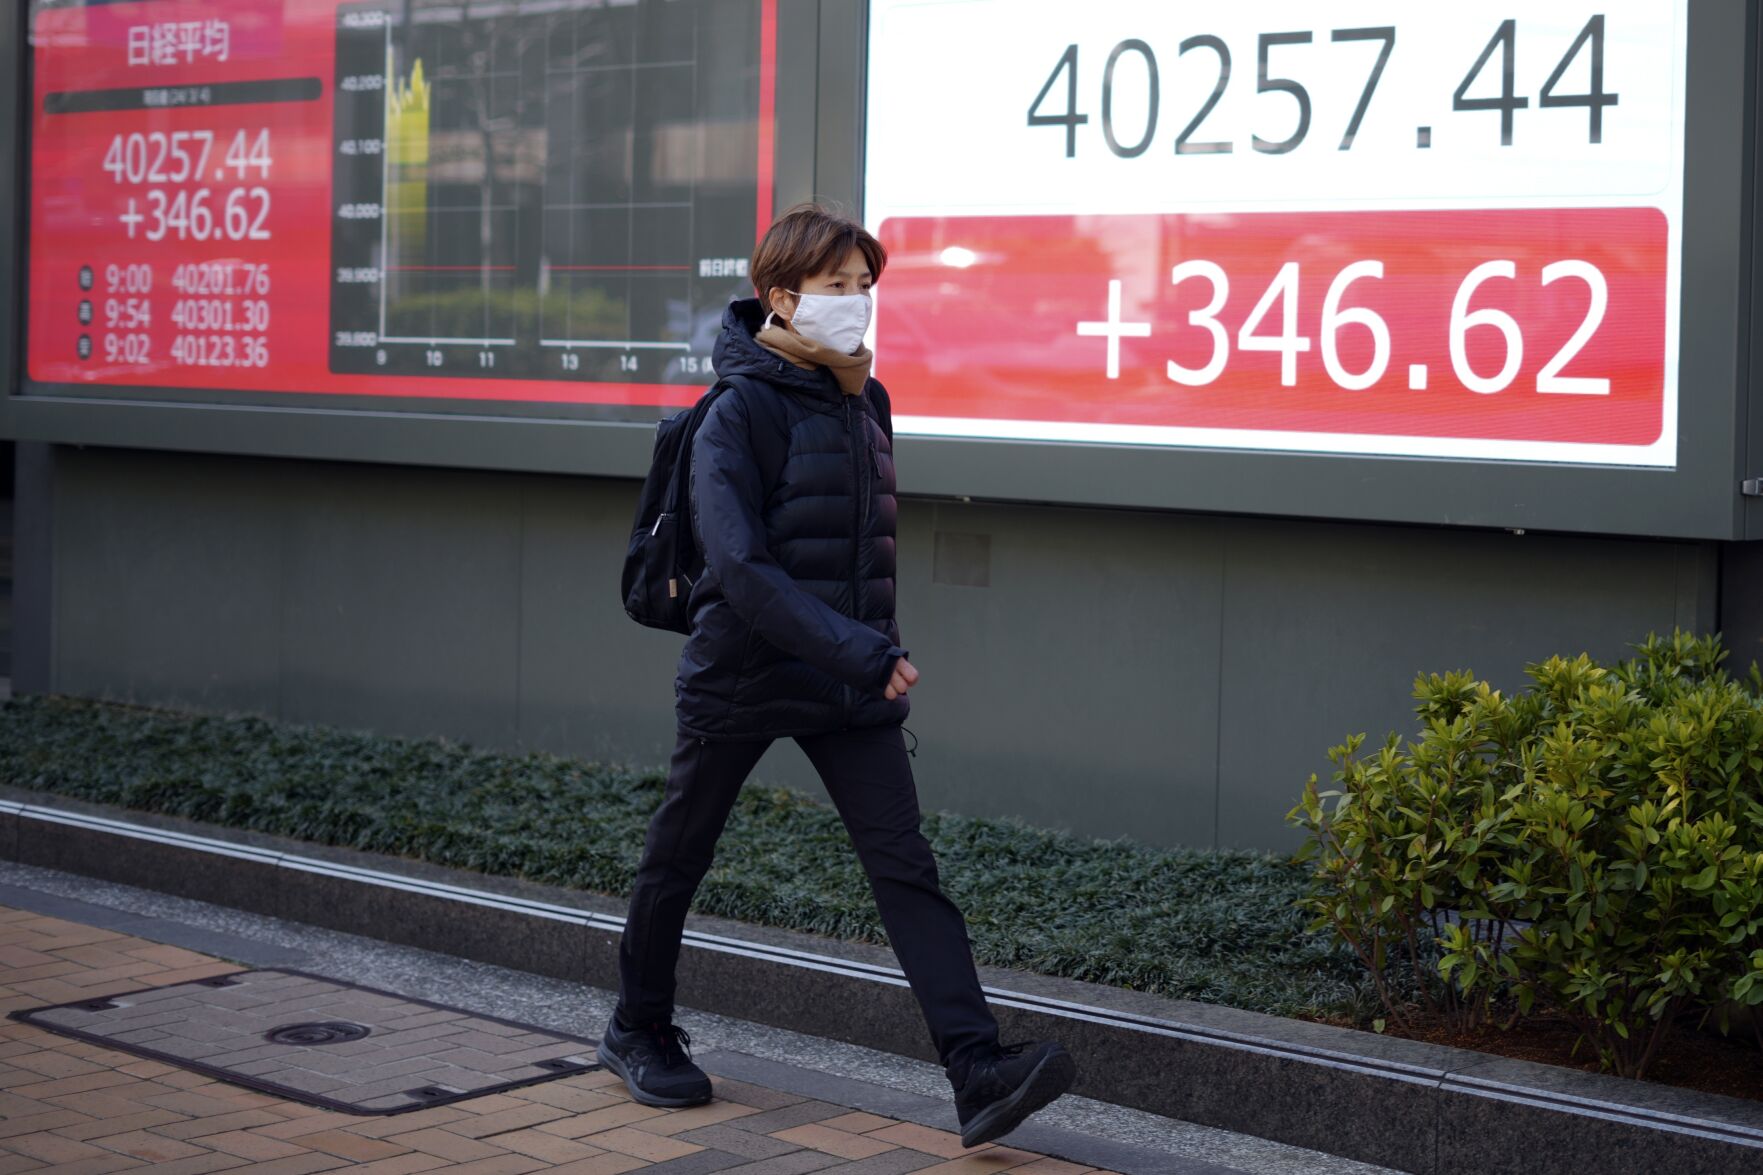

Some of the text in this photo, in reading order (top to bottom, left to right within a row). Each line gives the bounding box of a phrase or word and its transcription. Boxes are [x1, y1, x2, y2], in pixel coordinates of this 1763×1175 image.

[127, 19, 230, 66] 日経平均
[1027, 14, 1619, 158] 40257.44
[103, 127, 272, 184] 40257.44
[119, 186, 271, 241] +346.62
[105, 264, 151, 294] 9:00
[172, 263, 270, 295] 40201.76
[104, 298, 150, 328] 9:54
[171, 299, 269, 331] 40301.30
[1076, 260, 1611, 394] +346.62
[104, 333, 150, 363] 9:02
[170, 334, 269, 367] 40123.36
[426, 350, 443, 367] 10
[479, 351, 495, 368] 11
[561, 353, 579, 370] 13
[620, 355, 638, 371] 14
[680, 356, 698, 373] 15
